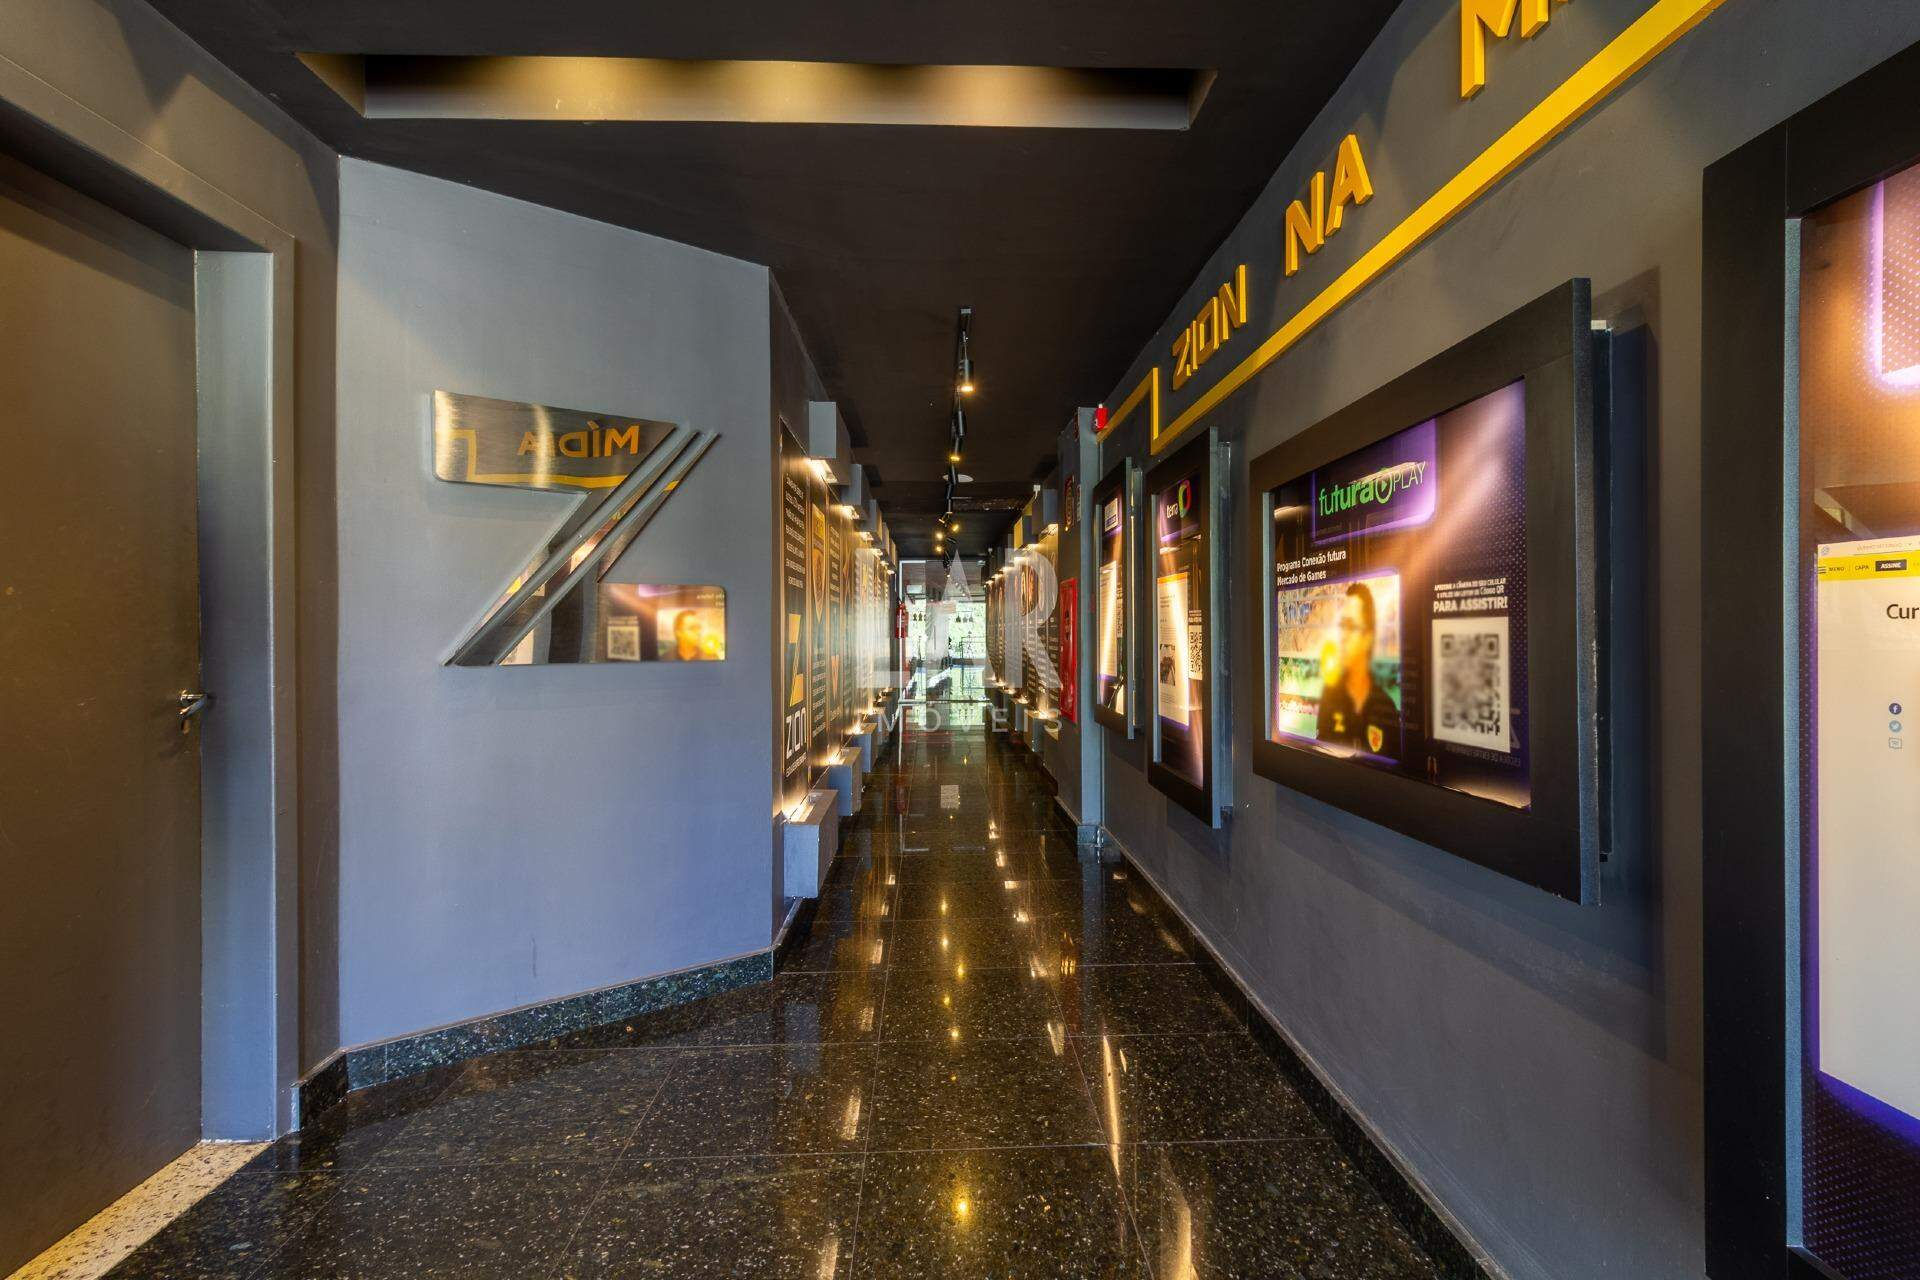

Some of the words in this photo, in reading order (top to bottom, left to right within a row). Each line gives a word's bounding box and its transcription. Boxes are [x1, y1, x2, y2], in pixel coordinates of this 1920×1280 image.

[1172, 264, 1247, 391] ZION
[1285, 134, 1374, 277] NA
[1461, 0, 1568, 98] M
[1318, 479, 1375, 516] futura
[1393, 461, 1426, 492] PLAY
[1277, 561, 1300, 572] Programa
[1302, 553, 1327, 567] Conexão
[1327, 550, 1346, 562] futura
[1277, 574, 1298, 586] Mercado
[1299, 572, 1306, 582] de
[1307, 571, 1327, 581] Games
[1433, 600, 1458, 613] PARA
[1460, 596, 1508, 611] ASSISTIR!
